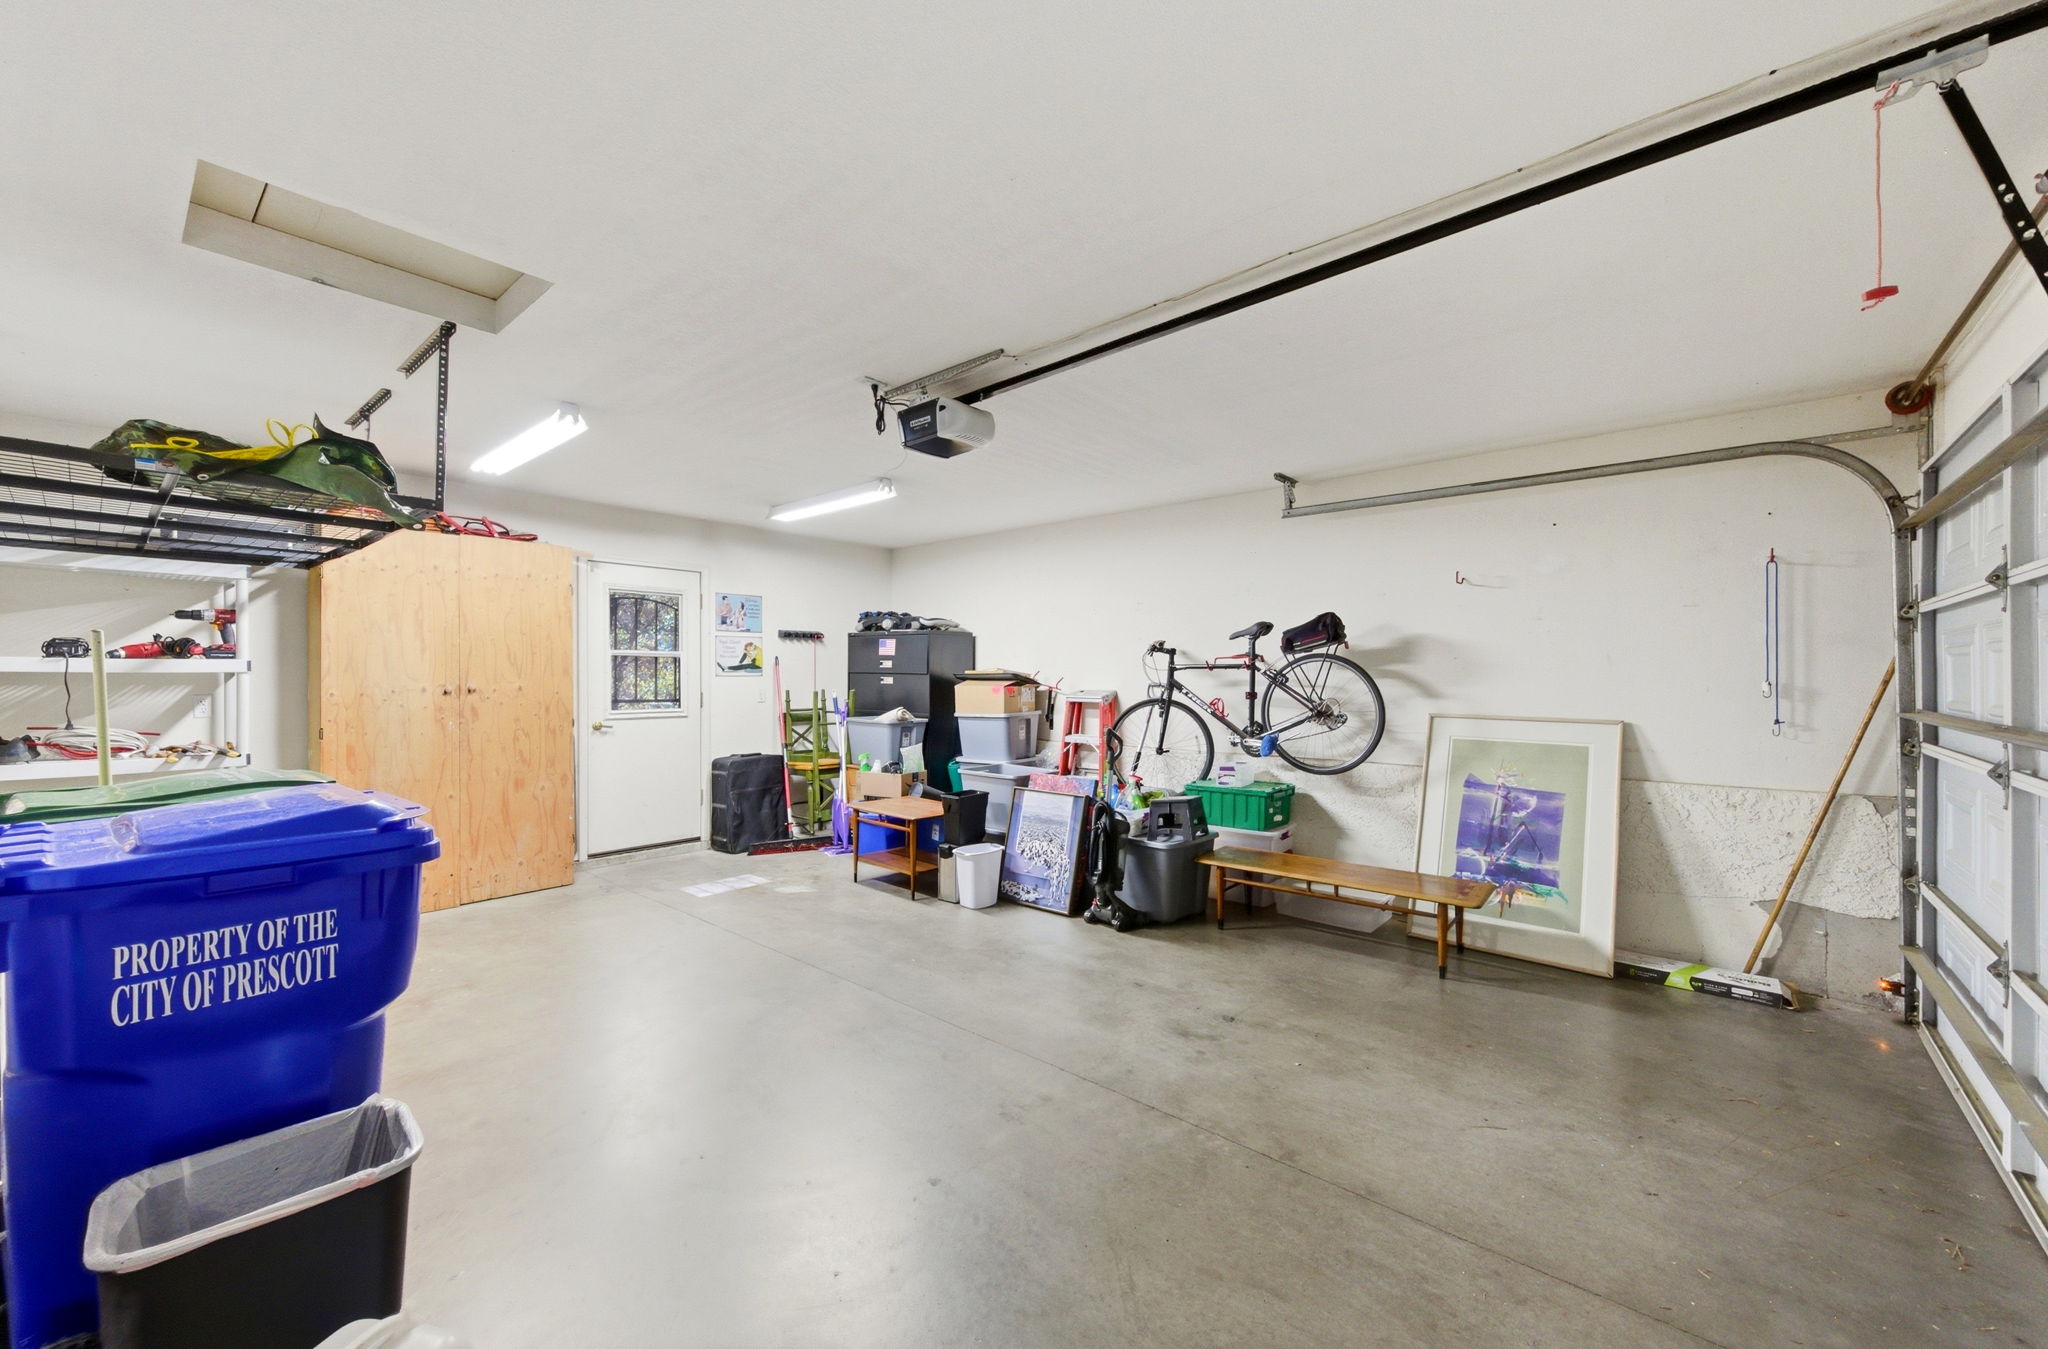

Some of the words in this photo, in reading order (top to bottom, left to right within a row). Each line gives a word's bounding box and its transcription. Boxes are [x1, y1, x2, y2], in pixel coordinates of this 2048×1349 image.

[112, 923, 253, 980] PROPERTY
[257, 917, 289, 951] OF
[293, 908, 339, 945] THE
[110, 975, 177, 1027] CITY
[182, 968, 217, 1011] OF
[221, 943, 339, 1004] PRESCOTT
